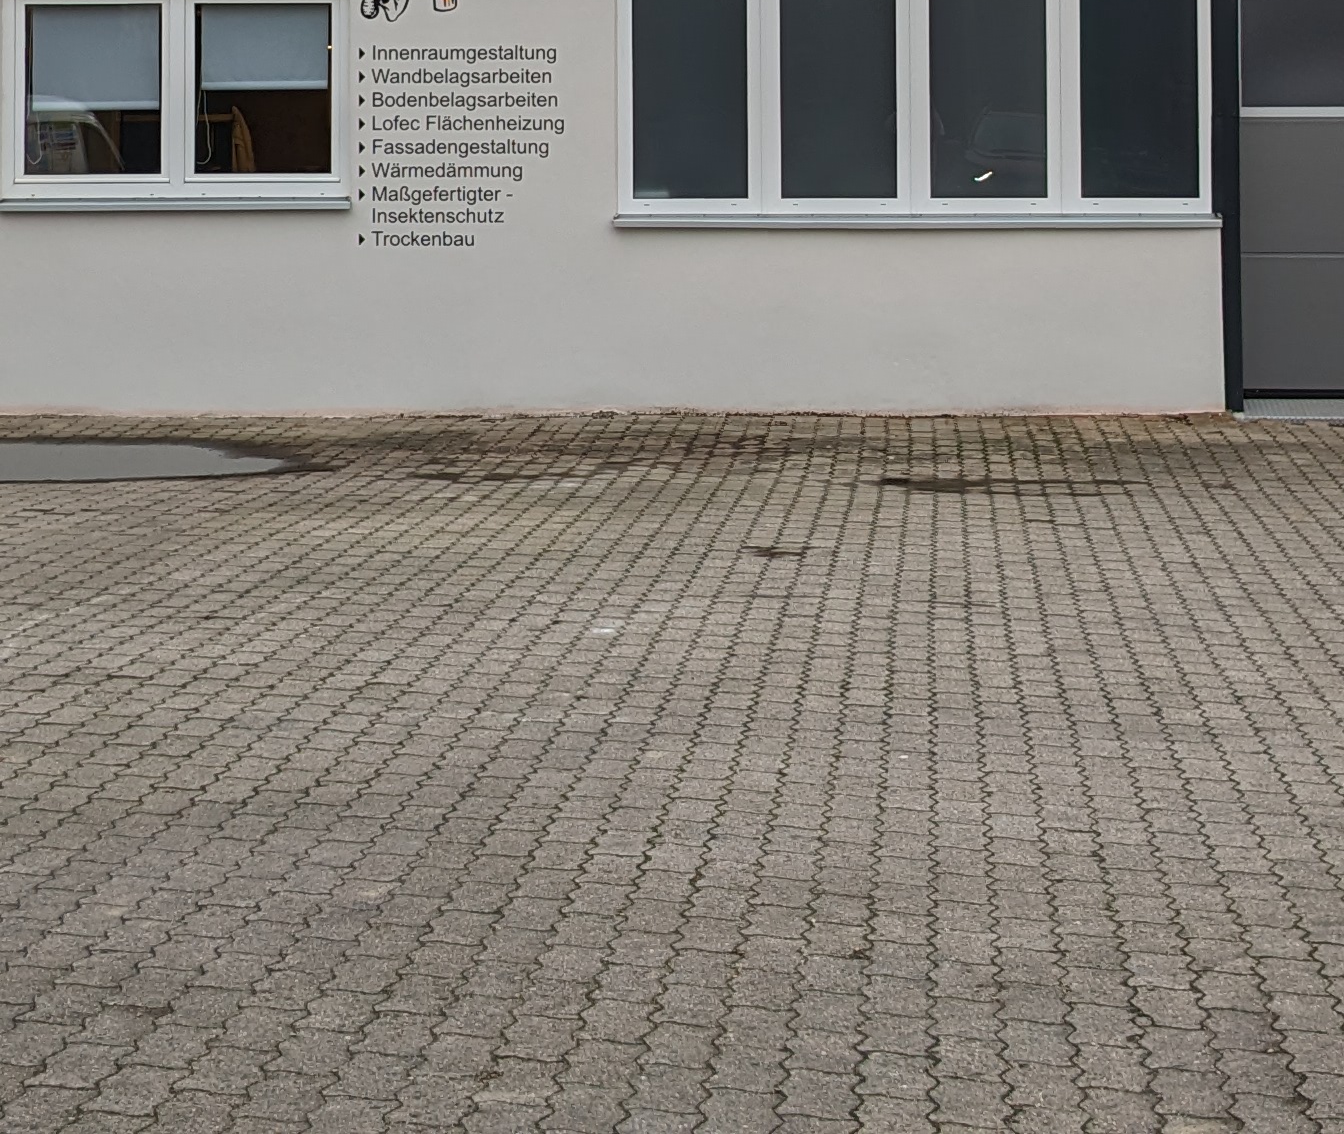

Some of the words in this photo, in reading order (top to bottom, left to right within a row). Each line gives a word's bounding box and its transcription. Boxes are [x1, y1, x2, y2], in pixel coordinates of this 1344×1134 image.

[372, 44, 557, 64] Innenraumgestaltung
[371, 68, 552, 87] Wandbelagsarbeiten
[371, 91, 558, 111] Bodenbelagsarbeiten
[371, 115, 420, 131] Lofec
[425, 115, 565, 134] Flächenheizung
[371, 138, 550, 158] Fassadengestaltung
[371, 162, 523, 181] Wärmedämmung
[371, 186, 501, 205] Maßgefertigter
[372, 207, 505, 224] Insektenschutz
[371, 230, 475, 247] Trockenbau
